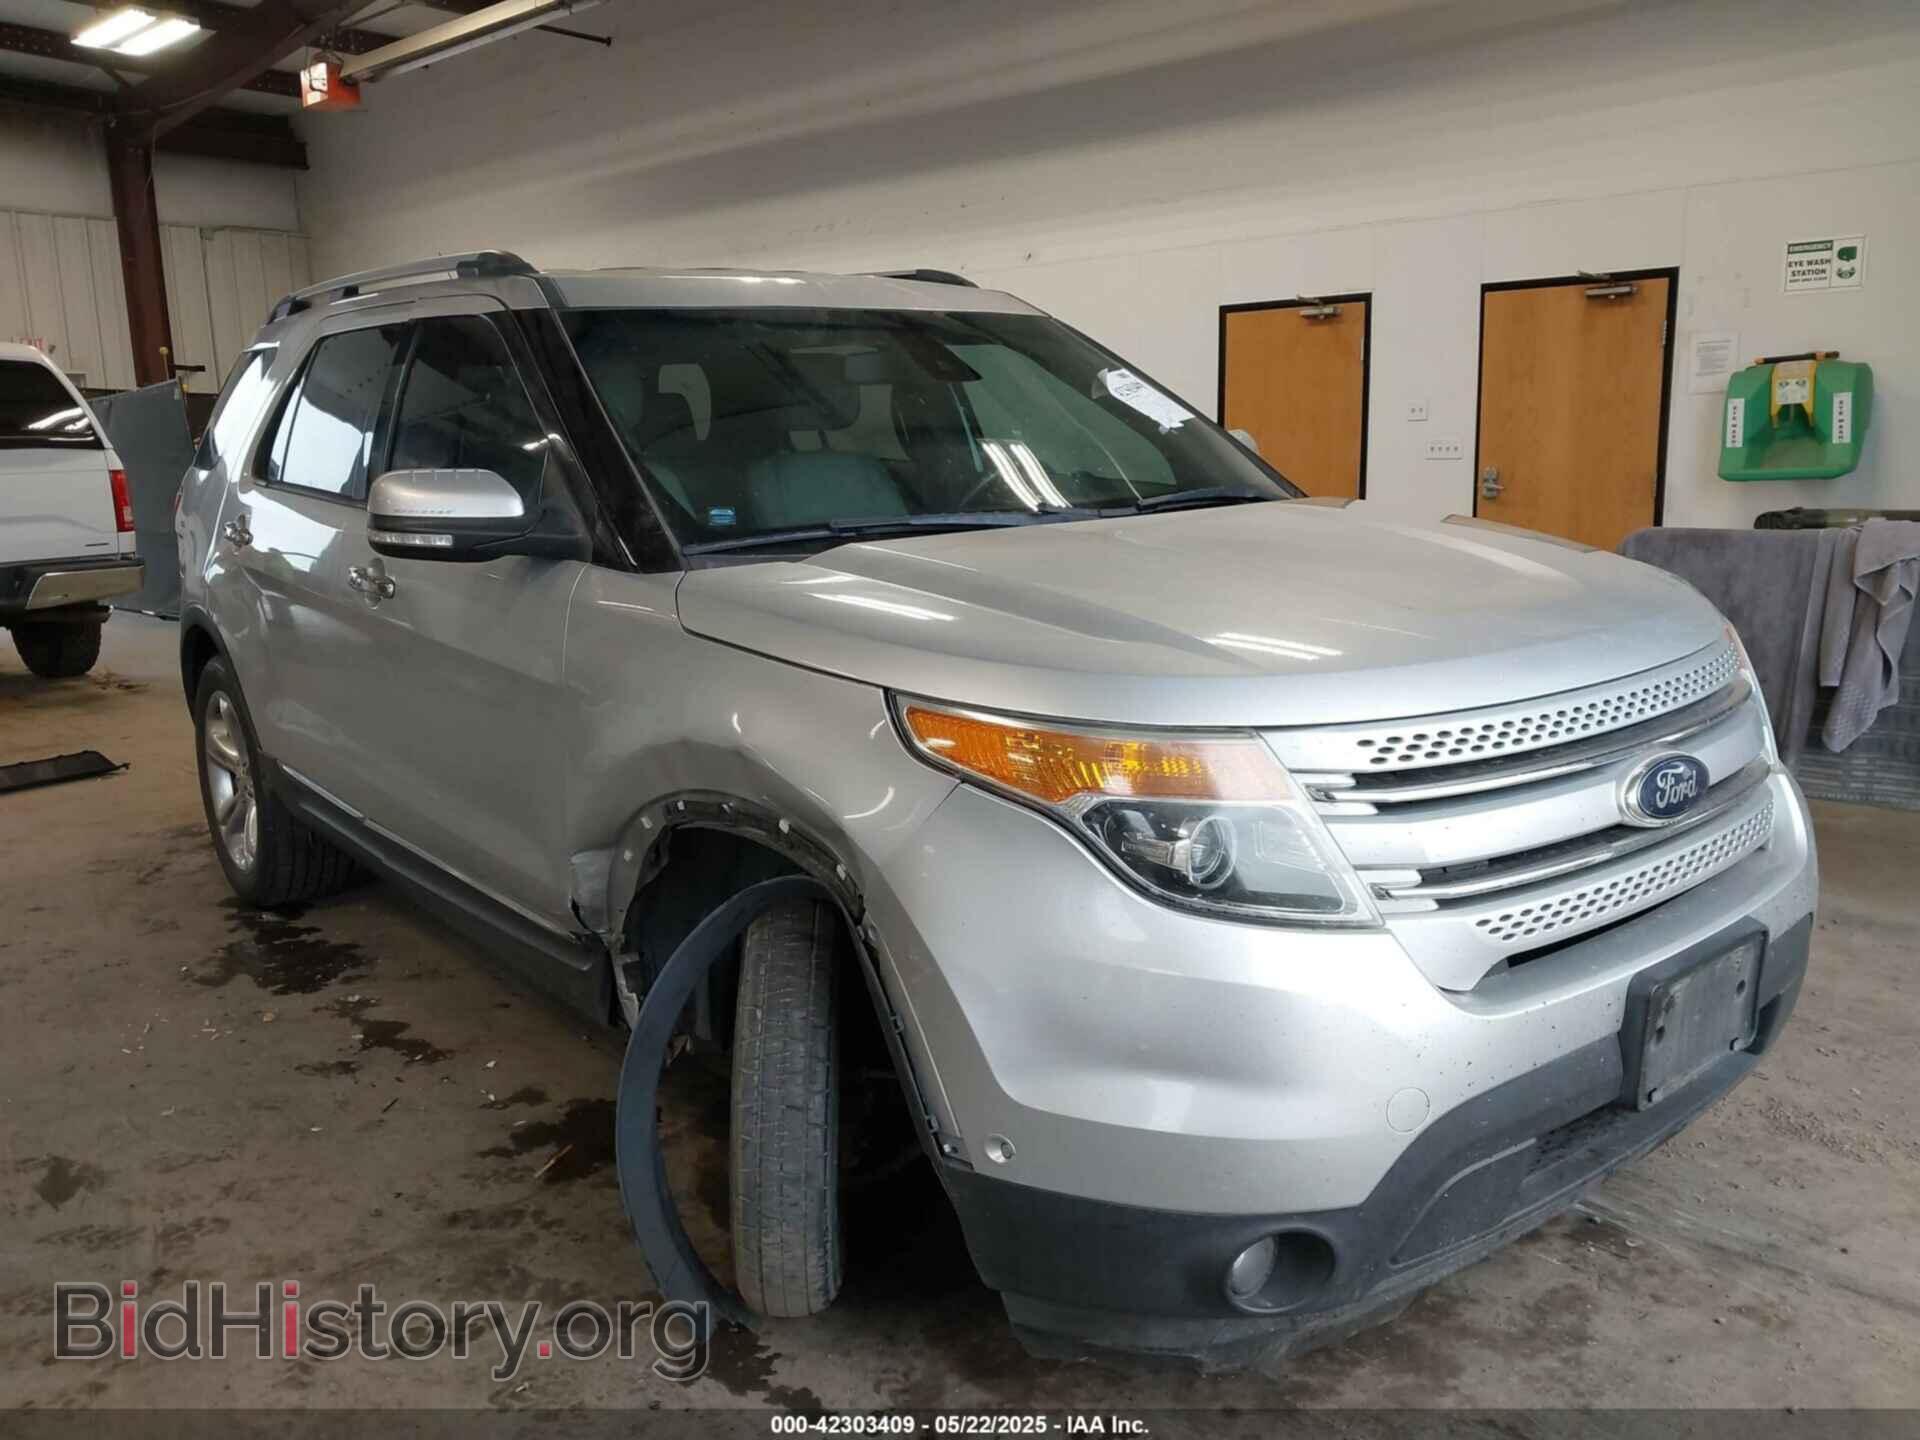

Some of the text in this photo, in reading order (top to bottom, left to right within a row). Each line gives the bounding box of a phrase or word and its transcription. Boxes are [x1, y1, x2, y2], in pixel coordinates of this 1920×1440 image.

[1788, 258, 1831, 268] EYE WASH
[1791, 268, 1826, 277] STATION
[1655, 762, 1697, 809] Ford
